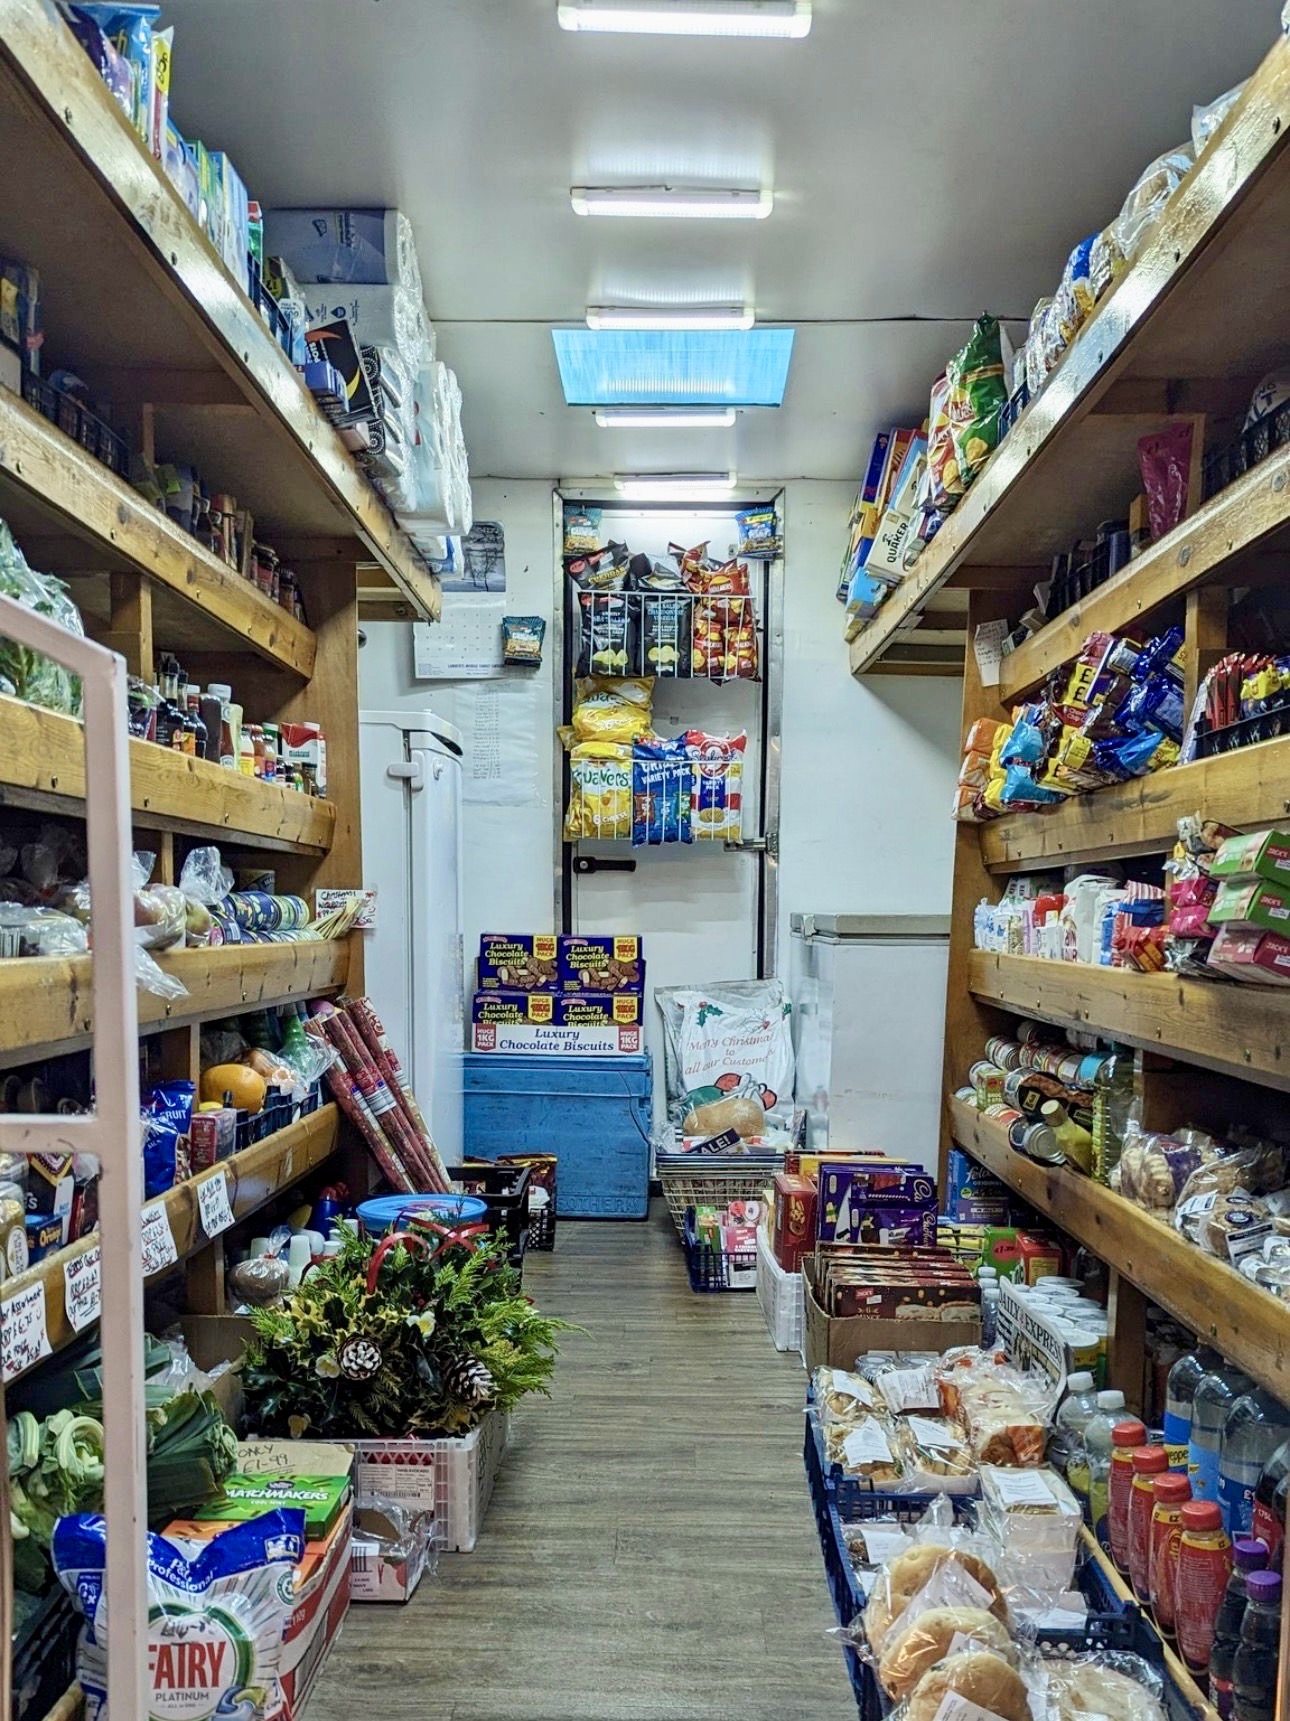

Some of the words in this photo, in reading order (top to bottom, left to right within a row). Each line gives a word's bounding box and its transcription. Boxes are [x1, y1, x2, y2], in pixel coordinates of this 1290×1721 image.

[886, 522, 909, 564] QUAKER
[571, 768, 630, 790] Quavers
[641, 770, 671, 785] VARIETY
[672, 767, 692, 778] PACK
[490, 942, 523, 951] Luxury
[535, 944, 555, 952] 1KG
[571, 945, 604, 953] Luxury
[616, 945, 635, 953] 1KG
[485, 950, 529, 958] Chocolate
[566, 952, 609, 960] Chocolate
[488, 957, 527, 966] Biscuits
[569, 959, 608, 969] Biscuits
[483, 1003, 518, 1012] Luxury
[530, 1004, 550, 1012] 1KG
[568, 1005, 603, 1014] Luxury
[615, 1005, 635, 1013] 1KG
[478, 1010, 523, 1019] Chocolate
[563, 1013, 609, 1022] Chocolate
[567, 1019, 608, 1027] Biscuits
[477, 1034, 495, 1042] 1KG
[535, 1028, 580, 1039] Luxury
[620, 1036, 638, 1044] 1KG
[689, 1038, 719, 1051] Merry
[500, 1040, 560, 1051] Chocolate
[563, 1041, 614, 1051] Biscuits
[726, 1048, 735, 1057] to
[685, 1062, 700, 1075] all
[702, 1059, 720, 1071] our
[698, 1134, 731, 1154] ALE!
[226, 1489, 329, 1501] MATCHMAKERS
[170, 1558, 193, 1583] P&G
[155, 1692, 209, 1702] PLATINUM
